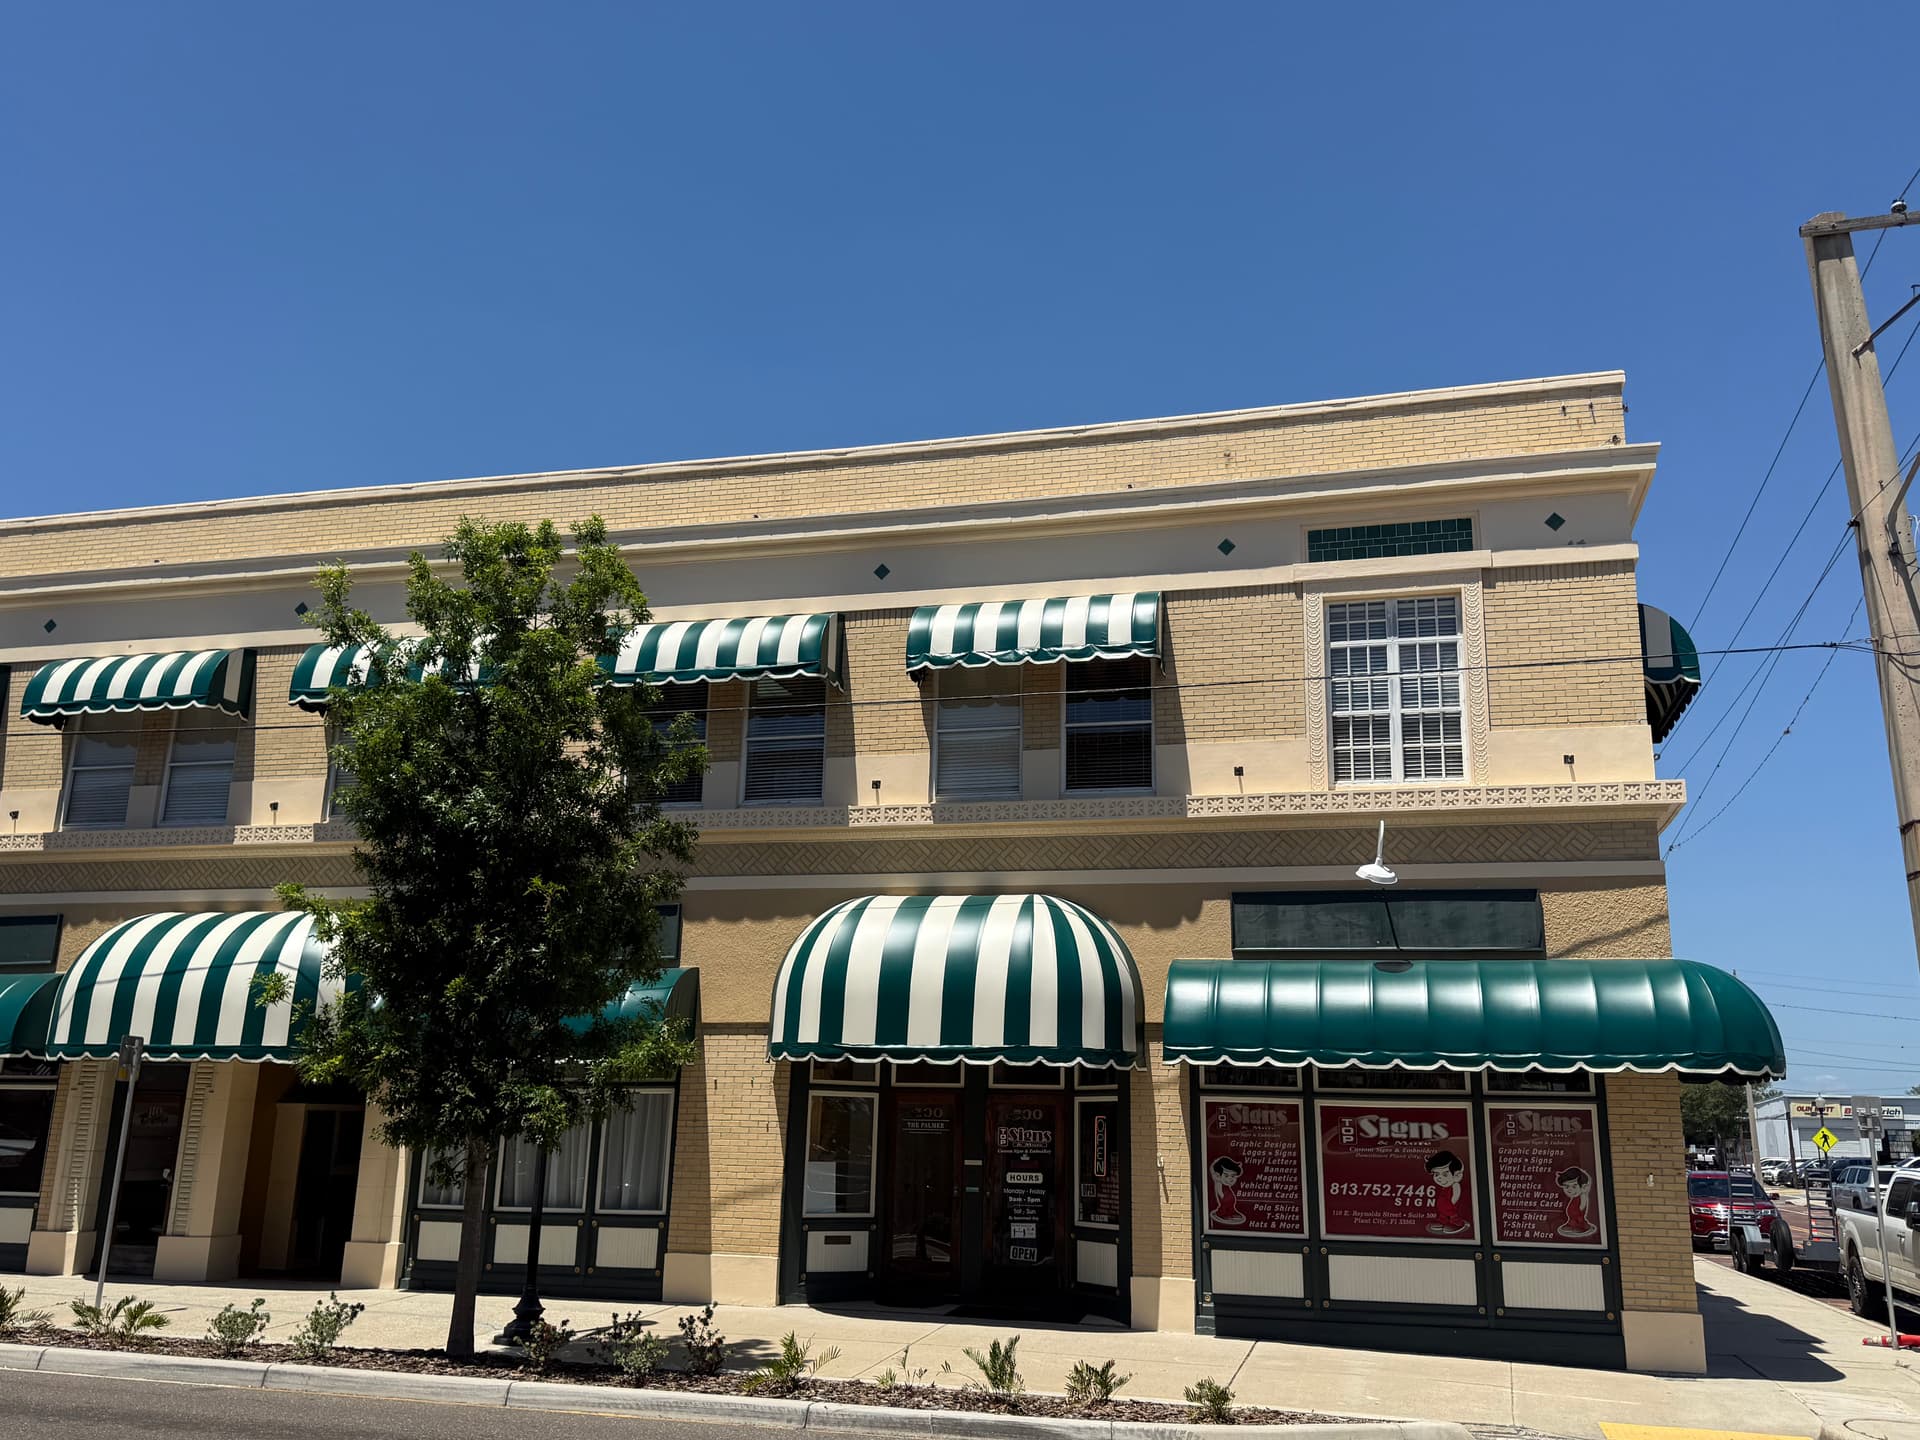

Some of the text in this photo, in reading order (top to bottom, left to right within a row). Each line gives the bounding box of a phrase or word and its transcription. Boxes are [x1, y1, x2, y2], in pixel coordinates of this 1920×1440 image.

[1218, 1104, 1288, 1129] TOP Signs
[1506, 1110, 1583, 1136] TOP Signs
[1341, 1114, 1449, 1144] TOP Signs
[1008, 1127, 1052, 1143] Signs
[1230, 1140, 1297, 1150] Graphic Designs
[1242, 1149, 1296, 1158] Logos Signs
[1498, 1147, 1564, 1157] Graphic Designs
[1244, 1157, 1297, 1165] Vinyl Letters
[1498, 1156, 1553, 1165] Logos Signs
[1499, 1164, 1552, 1173] Vinyl Letters
[1010, 1174, 1039, 1182] HOURS
[1256, 1173, 1298, 1182] Magnetics
[1500, 1173, 1533, 1181] Banners
[1240, 1182, 1298, 1192] Vehicle Wraps
[1500, 1181, 1541, 1190] Magnetics
[1236, 1190, 1299, 1199] Business Cards
[1330, 1182, 1436, 1199] 813.752.7446
[1501, 1190, 1559, 1199] Vehicle Wraps
[1394, 1197, 1436, 1207] SIGN
[1501, 1199, 1563, 1208] Business Cards
[1274, 1204, 1299, 1213] Shirts
[1266, 1212, 1299, 1221] T-Shirts
[1502, 1212, 1547, 1221] Polo Shirts
[1249, 1220, 1268, 1228] Hats
[1279, 1221, 1300, 1229] More
[1503, 1221, 1536, 1229] T-Shirts
[1503, 1230, 1522, 1238] Hats
[1533, 1231, 1554, 1239] More
[1012, 1247, 1036, 1260] OPEN
